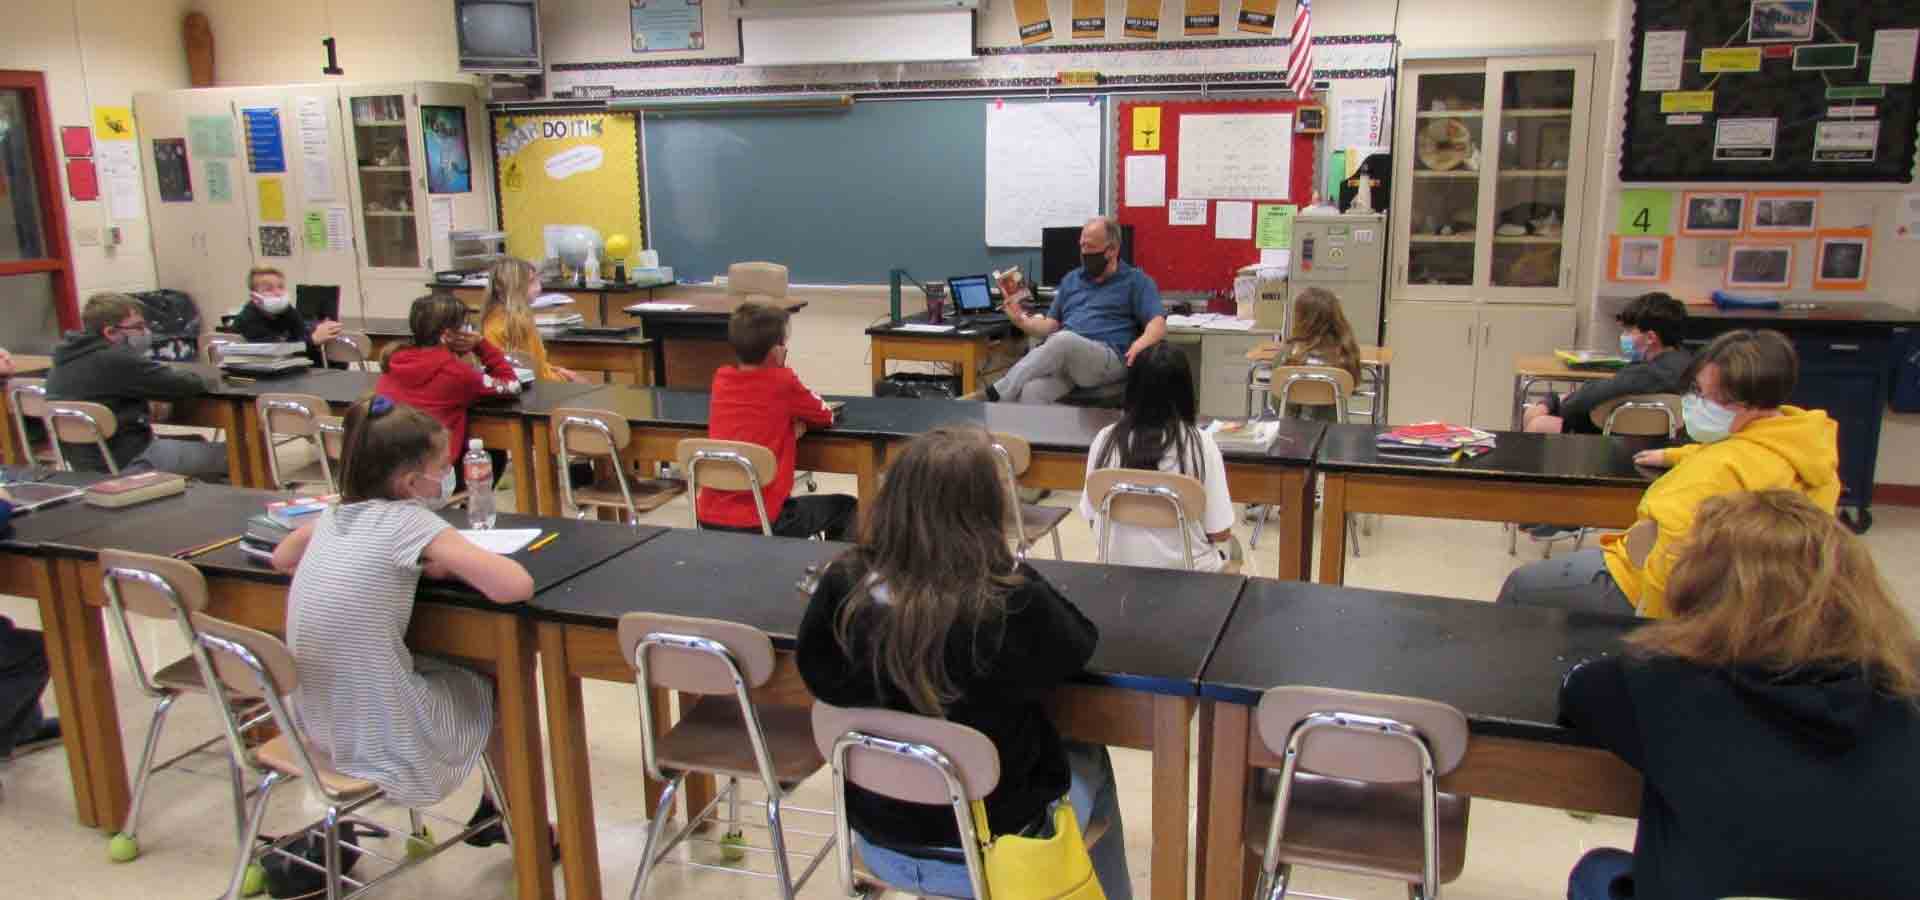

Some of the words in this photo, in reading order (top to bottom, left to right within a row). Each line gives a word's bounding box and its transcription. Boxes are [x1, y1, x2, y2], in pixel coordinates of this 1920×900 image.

[323, 37, 344, 75] 1
[543, 121, 567, 138] DO
[1632, 208, 1652, 232] 4
